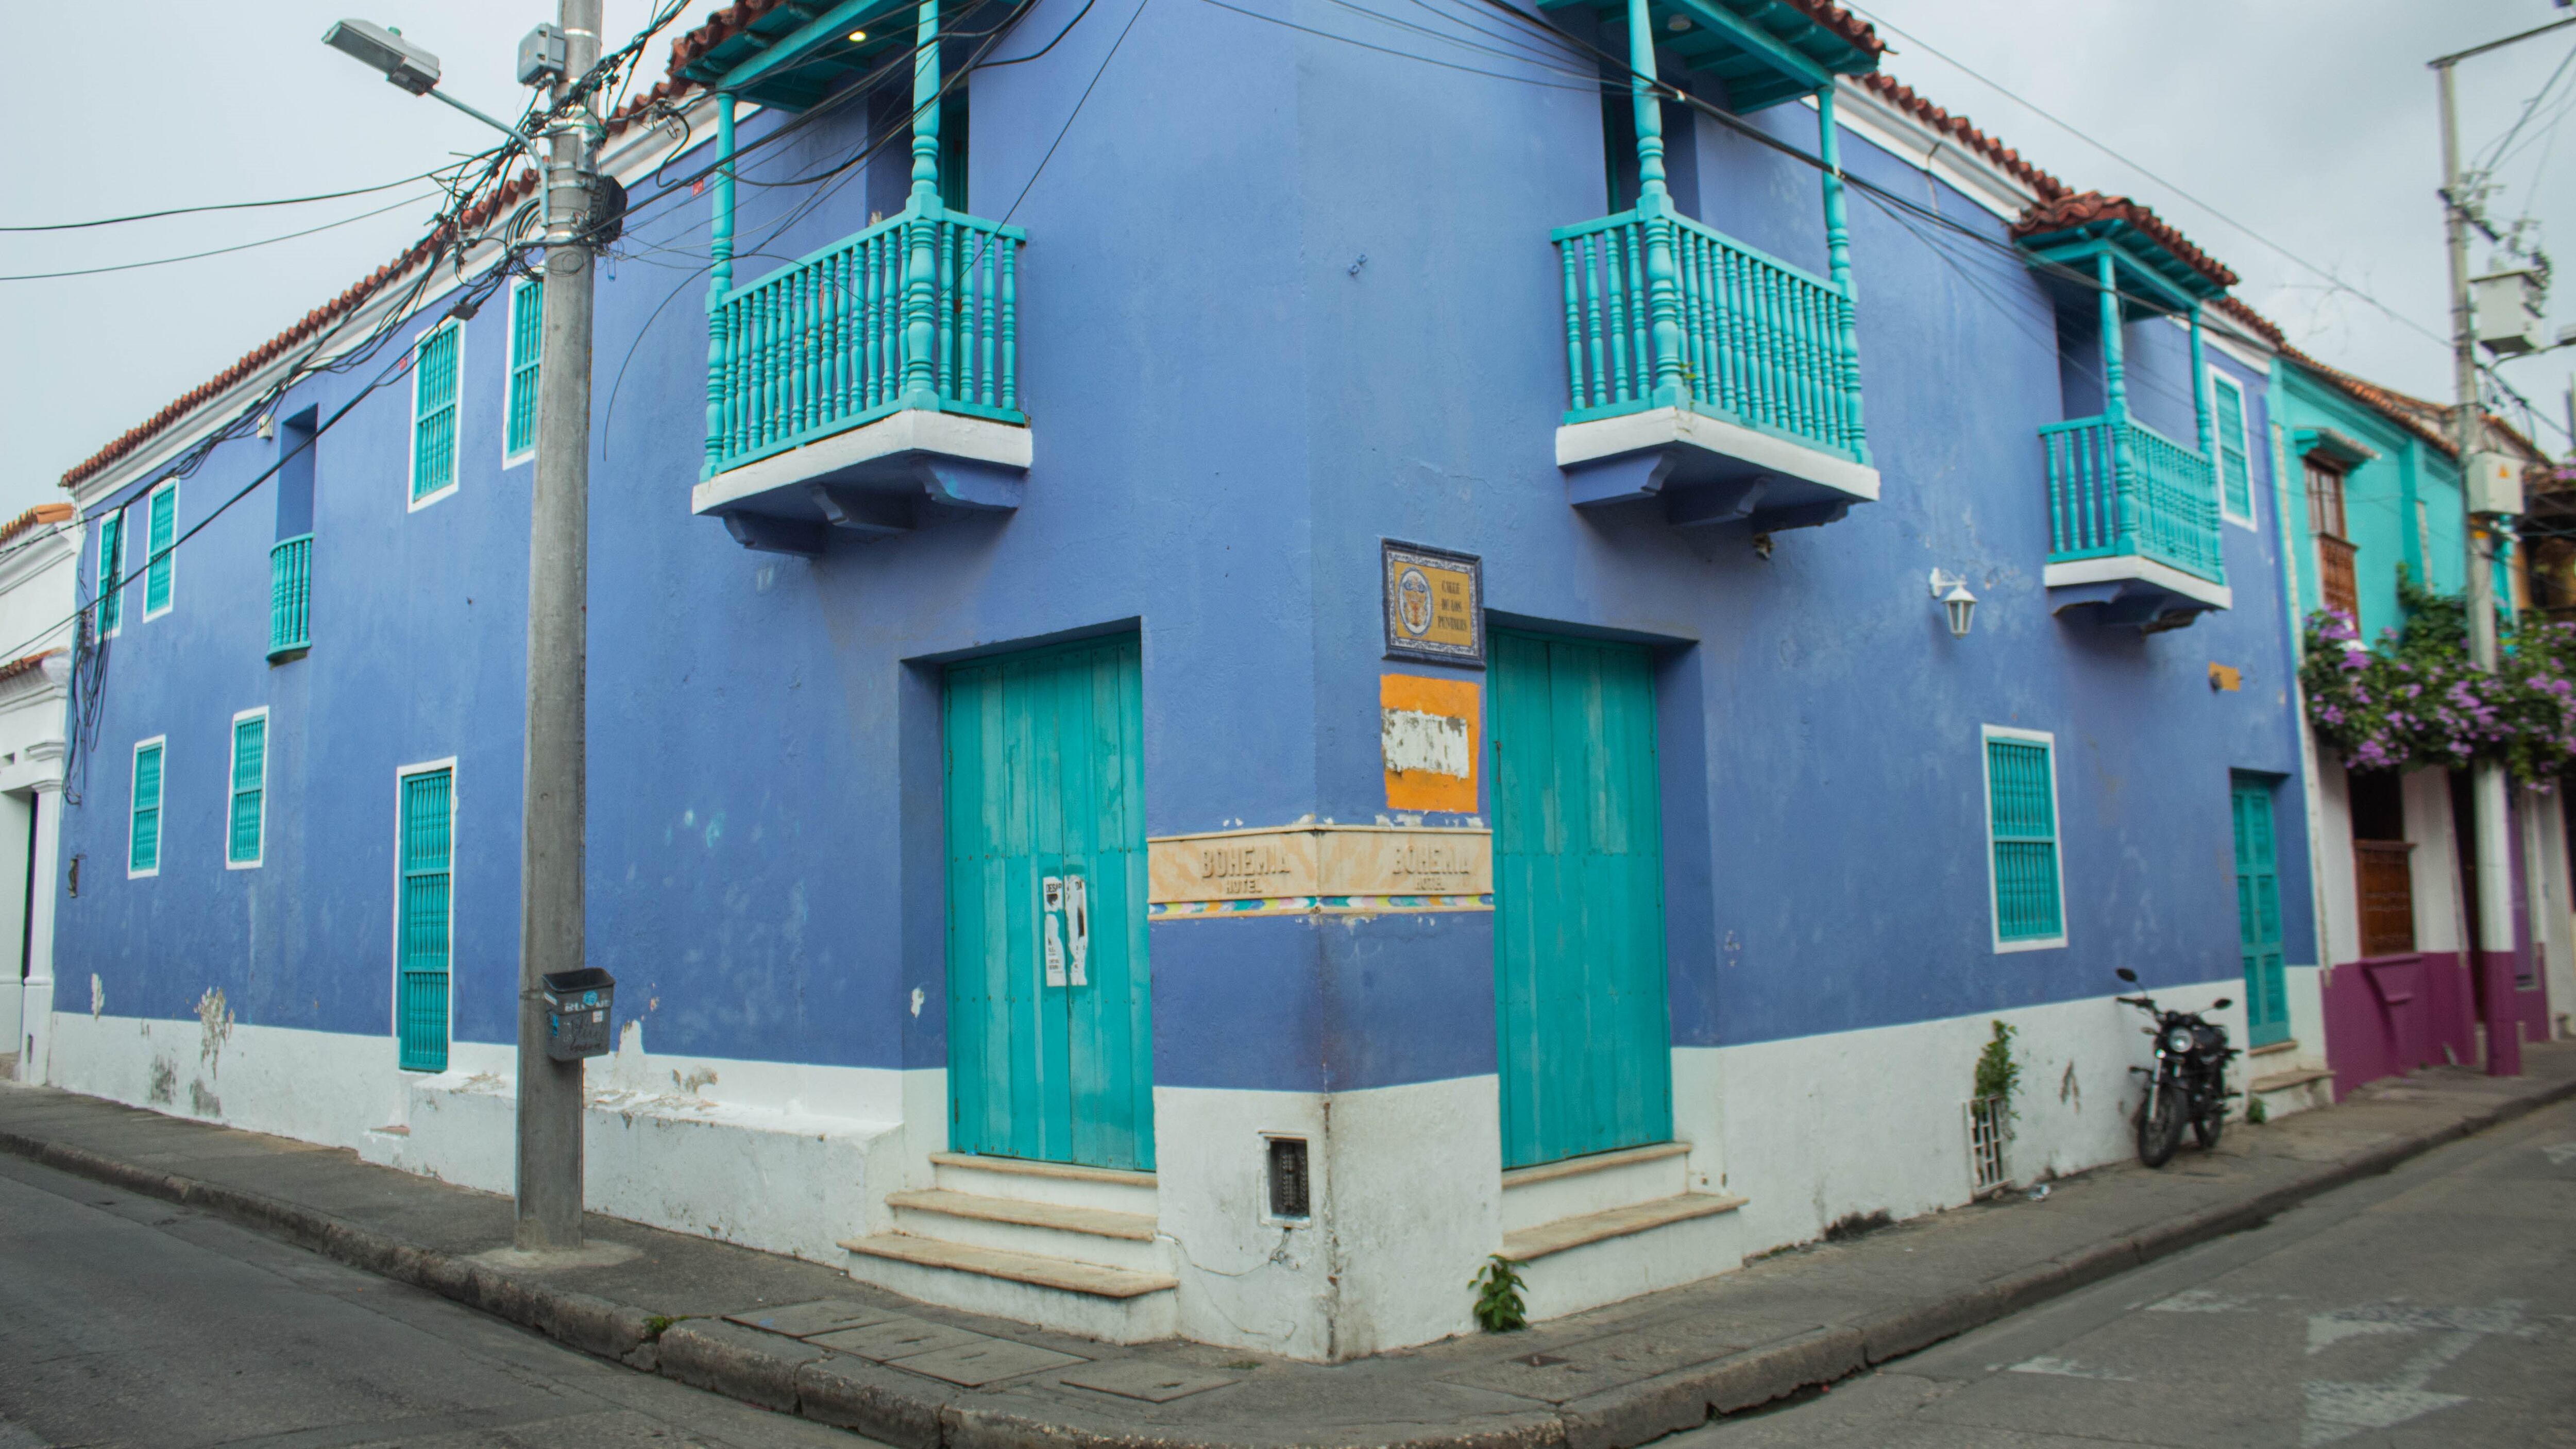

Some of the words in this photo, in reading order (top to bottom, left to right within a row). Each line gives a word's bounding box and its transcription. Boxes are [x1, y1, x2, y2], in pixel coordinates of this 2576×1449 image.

[1442, 580, 1460, 595] CALLE
[1202, 844, 1292, 878] BOHEMIA
[1392, 845, 1470, 875] BOHEMIA
[1226, 878, 1262, 894] HOTEL
[1415, 876, 1446, 891] HOTEL
